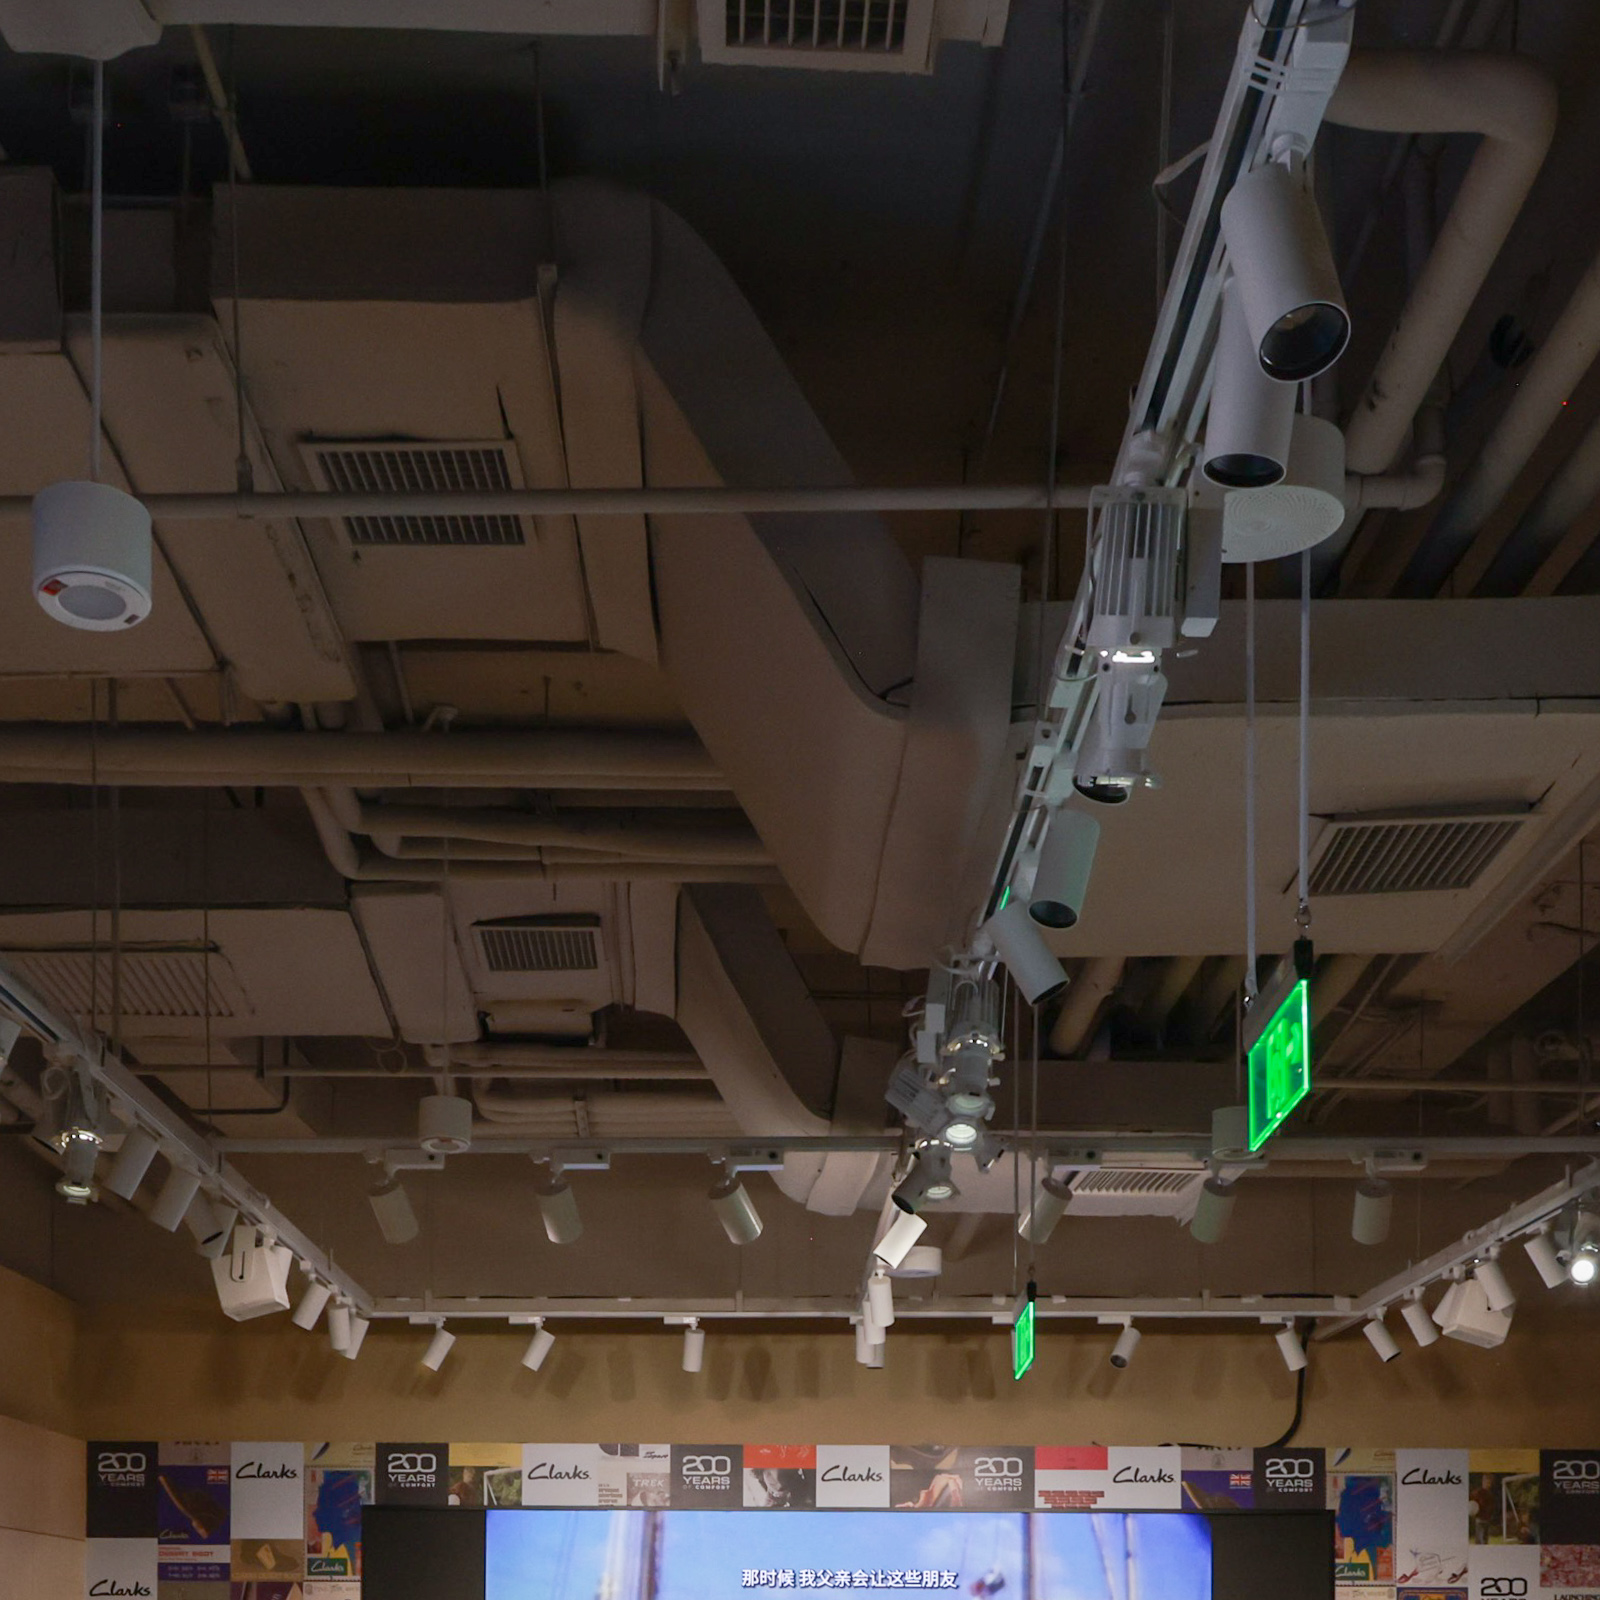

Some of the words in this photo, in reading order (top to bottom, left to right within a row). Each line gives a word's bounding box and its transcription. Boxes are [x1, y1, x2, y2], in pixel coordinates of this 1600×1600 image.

[98, 1452, 147, 1472] 200
[235, 1461, 297, 1479] Clarks
[387, 1453, 437, 1473] 200
[527, 1462, 590, 1480] Clarks
[681, 1455, 731, 1476] 200
[974, 1456, 1023, 1477] 200
[1264, 1458, 1314, 1478] 200
[1553, 1460, 1600, 1480] 200
[98, 1473, 146, 1482] YEARS
[388, 1474, 436, 1483] YEARS
[682, 1476, 731, 1485] YEARS
[821, 1464, 884, 1482] Clarks
[975, 1477, 1023, 1486] YEARS
[1112, 1466, 1175, 1483] Clarks
[1401, 1468, 1463, 1485] Clarks
[633, 1478, 665, 1488] TREK
[1266, 1479, 1314, 1488] YEARS
[1553, 1481, 1600, 1490] YEARS
[310, 1559, 345, 1572] Clarks
[741, 1569, 796, 1588] 那时候
[798, 1569, 959, 1588] 我父亲会让这些朋友
[1480, 1577, 1528, 1596] 200
[89, 1579, 151, 1597] Clarks
